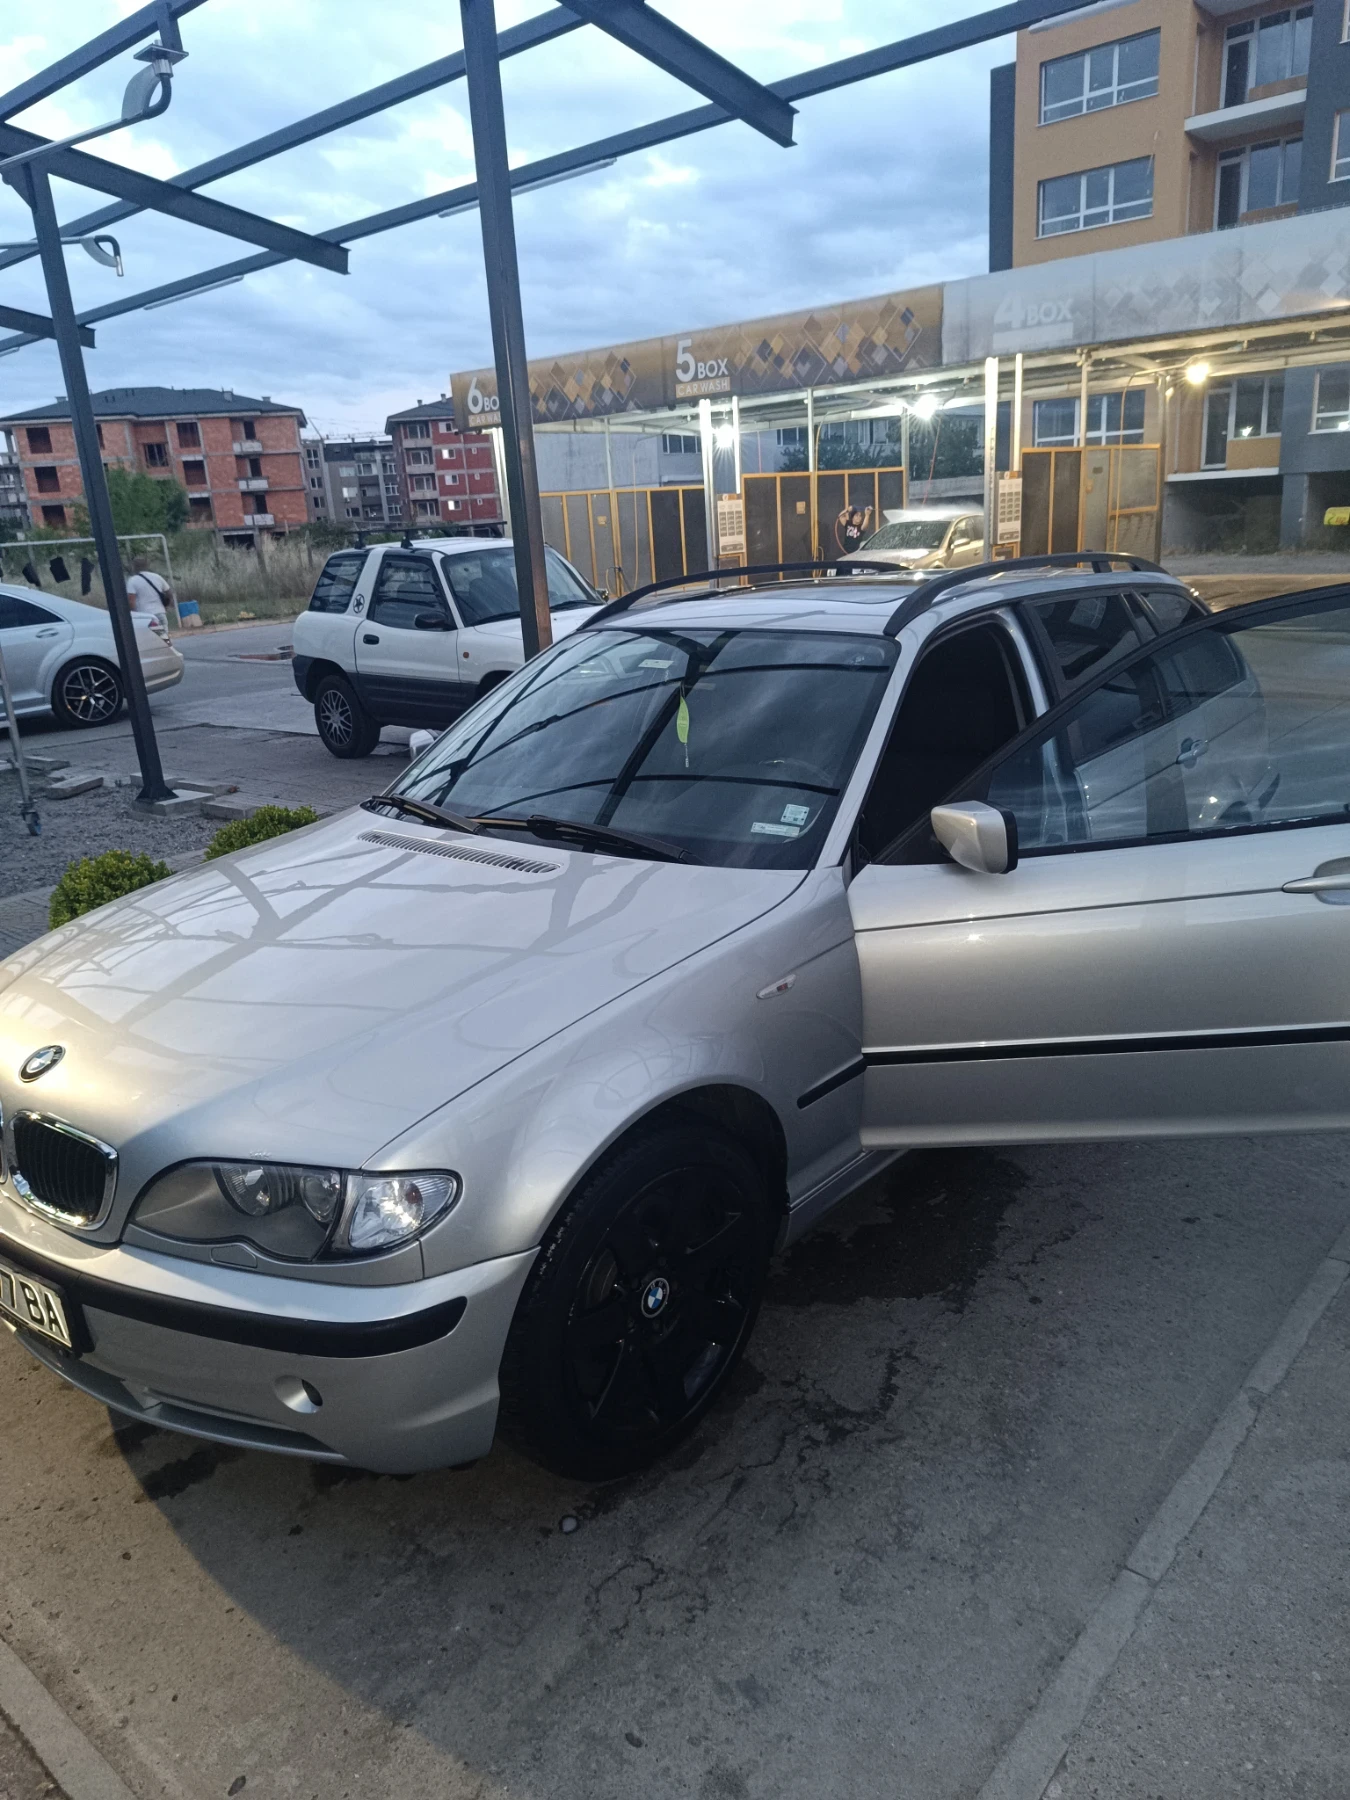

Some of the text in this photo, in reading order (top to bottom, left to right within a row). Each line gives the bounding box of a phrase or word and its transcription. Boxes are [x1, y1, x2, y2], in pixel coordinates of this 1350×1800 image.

[994, 291, 1074, 328] 4 BOX
[676, 339, 728, 382] 5 BOX
[468, 377, 500, 414] 6 BO
[677, 379, 728, 396] CAR WASH
